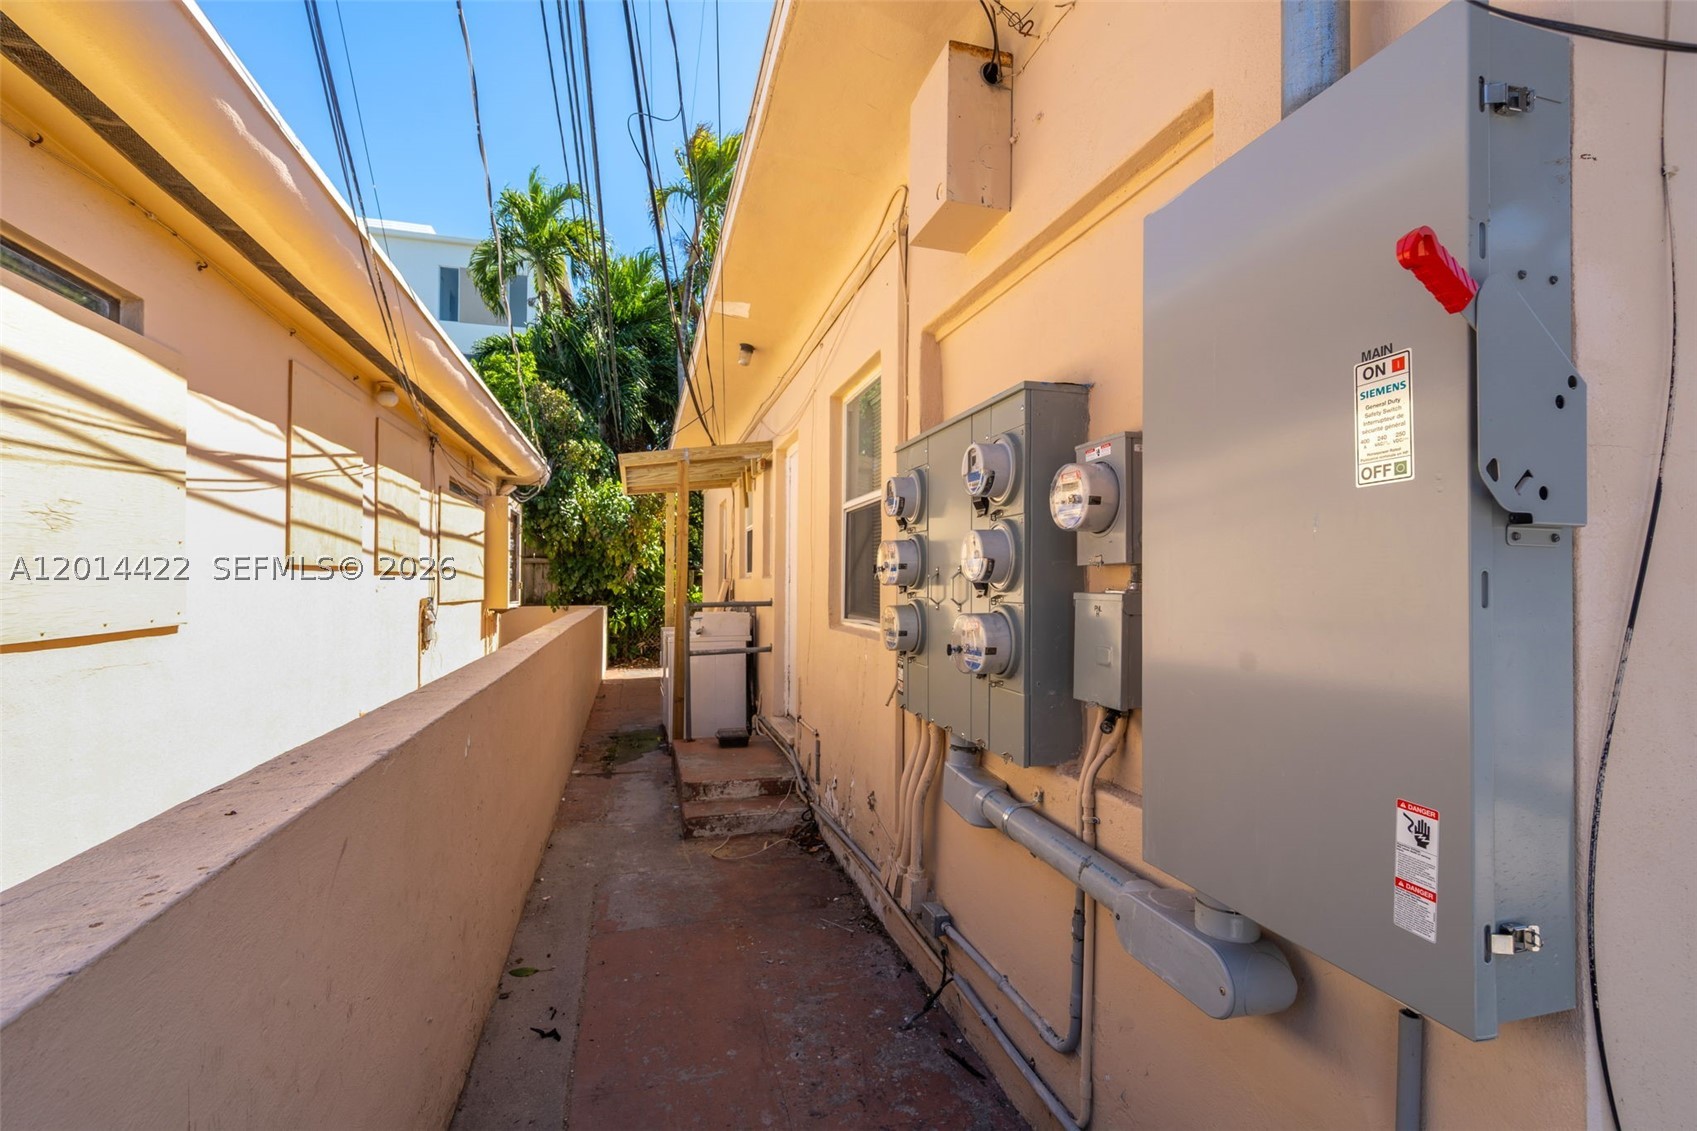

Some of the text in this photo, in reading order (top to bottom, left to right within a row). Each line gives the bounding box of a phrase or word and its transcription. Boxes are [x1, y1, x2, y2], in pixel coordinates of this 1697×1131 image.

[1361, 343, 1393, 362] MAIN
[1363, 362, 1386, 380] ON
[1360, 381, 1407, 400] SIEMENS
[1365, 400, 1387, 410] General
[1383, 405, 1402, 414] Switch
[1361, 463, 1392, 480] OFF
[1407, 803, 1436, 818] DANGER
[1405, 882, 1434, 899] DANGER
